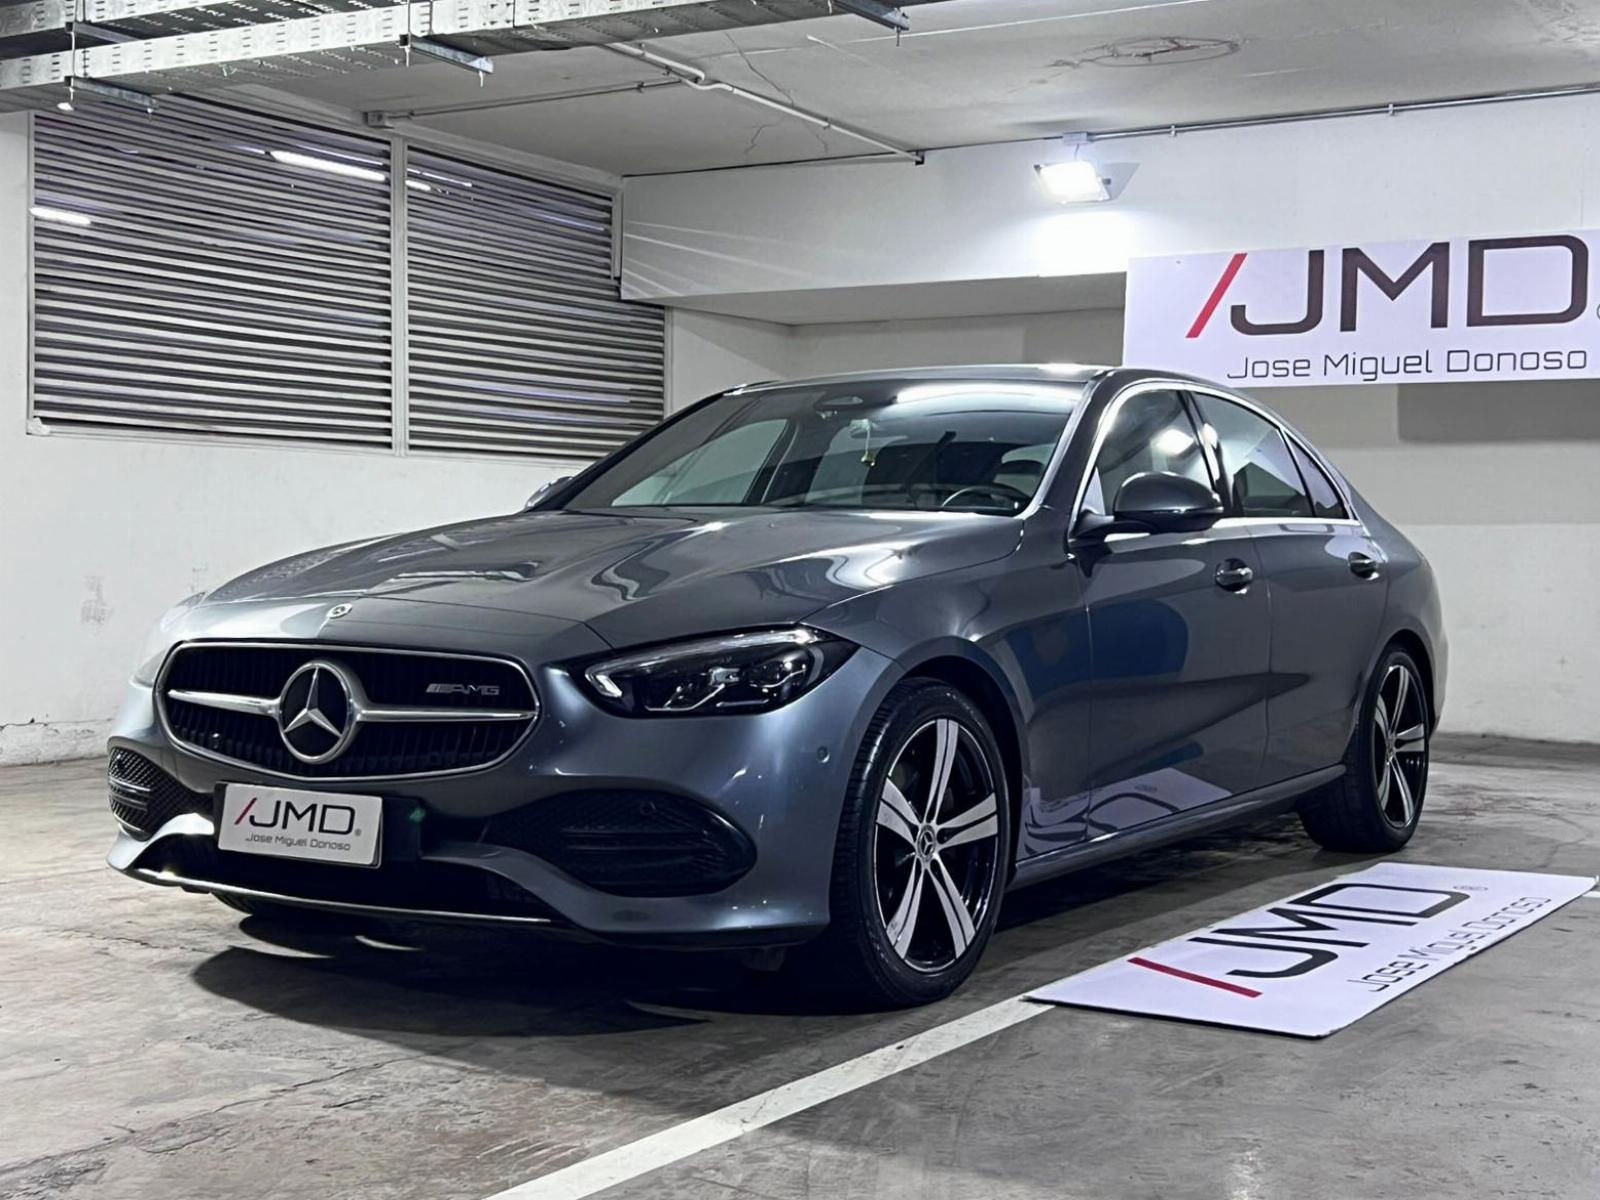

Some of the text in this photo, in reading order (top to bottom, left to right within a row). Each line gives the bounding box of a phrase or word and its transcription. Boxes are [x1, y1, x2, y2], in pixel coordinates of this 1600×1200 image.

[1227, 349, 1588, 382] Jose Miguel Donoso
[245, 833, 351, 851] Jose Miguel Donoso
[1347, 960, 1430, 992] Jose
